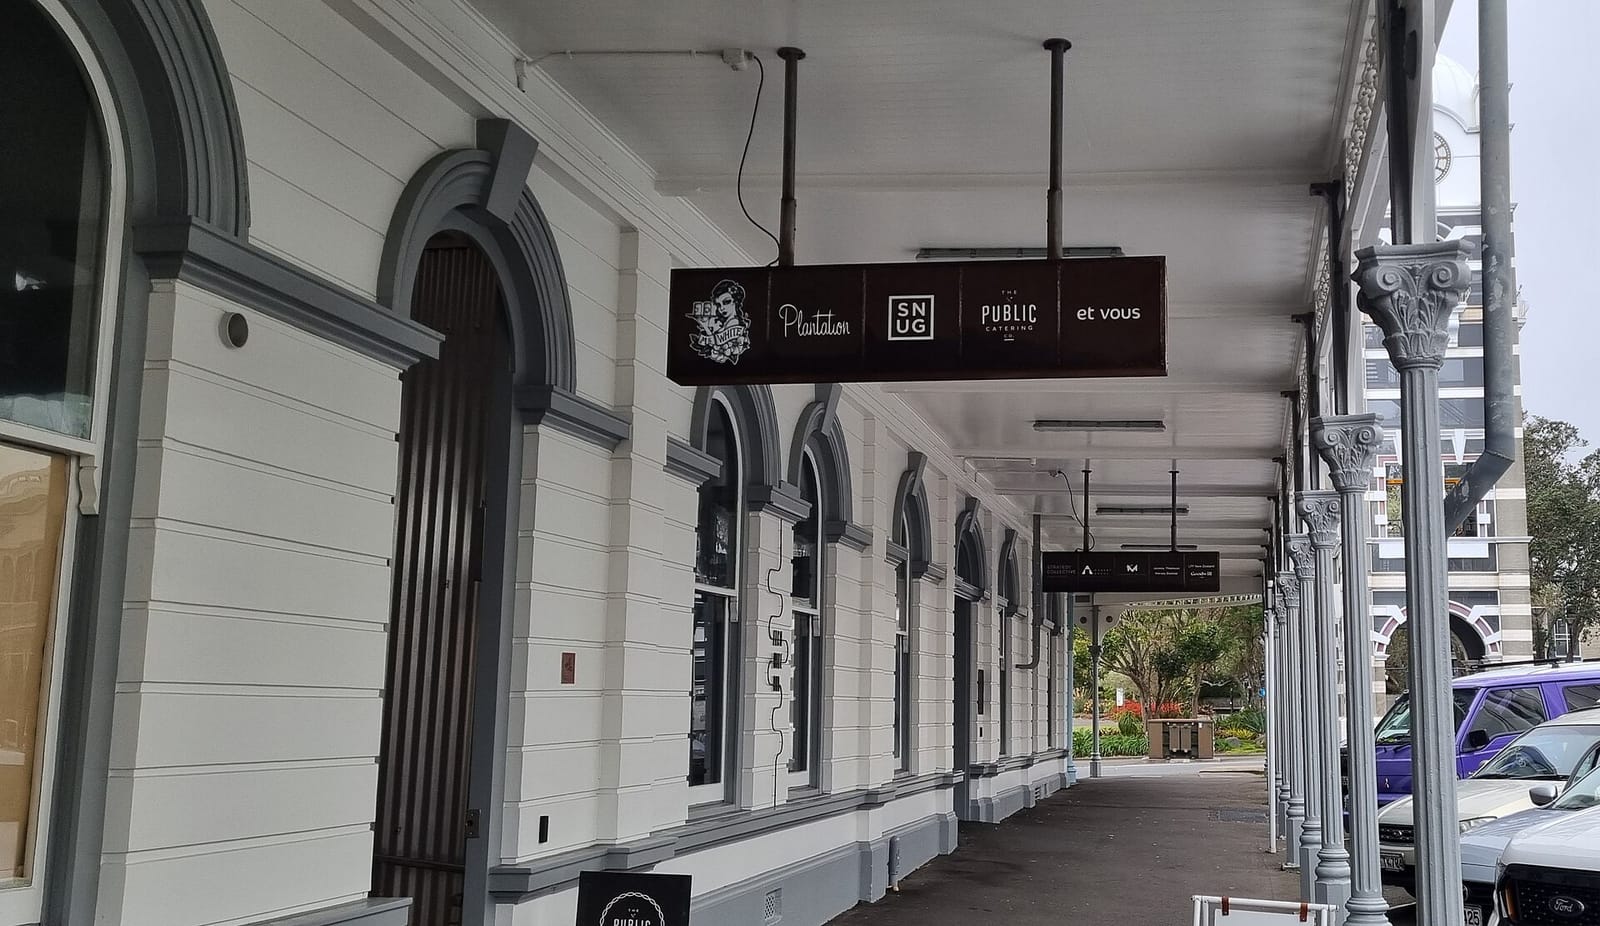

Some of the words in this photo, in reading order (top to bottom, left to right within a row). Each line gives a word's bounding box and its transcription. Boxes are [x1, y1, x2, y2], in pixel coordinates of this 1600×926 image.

[897, 302, 926, 318] SN
[981, 304, 1037, 325] PUBLIC
[1076, 306, 1095, 321] et
[1099, 306, 1141, 321] vous
[778, 303, 850, 338] Plantation
[896, 318, 926, 334] UG
[717, 328, 742, 343] WHITE
[1553, 898, 1574, 912] Ford
